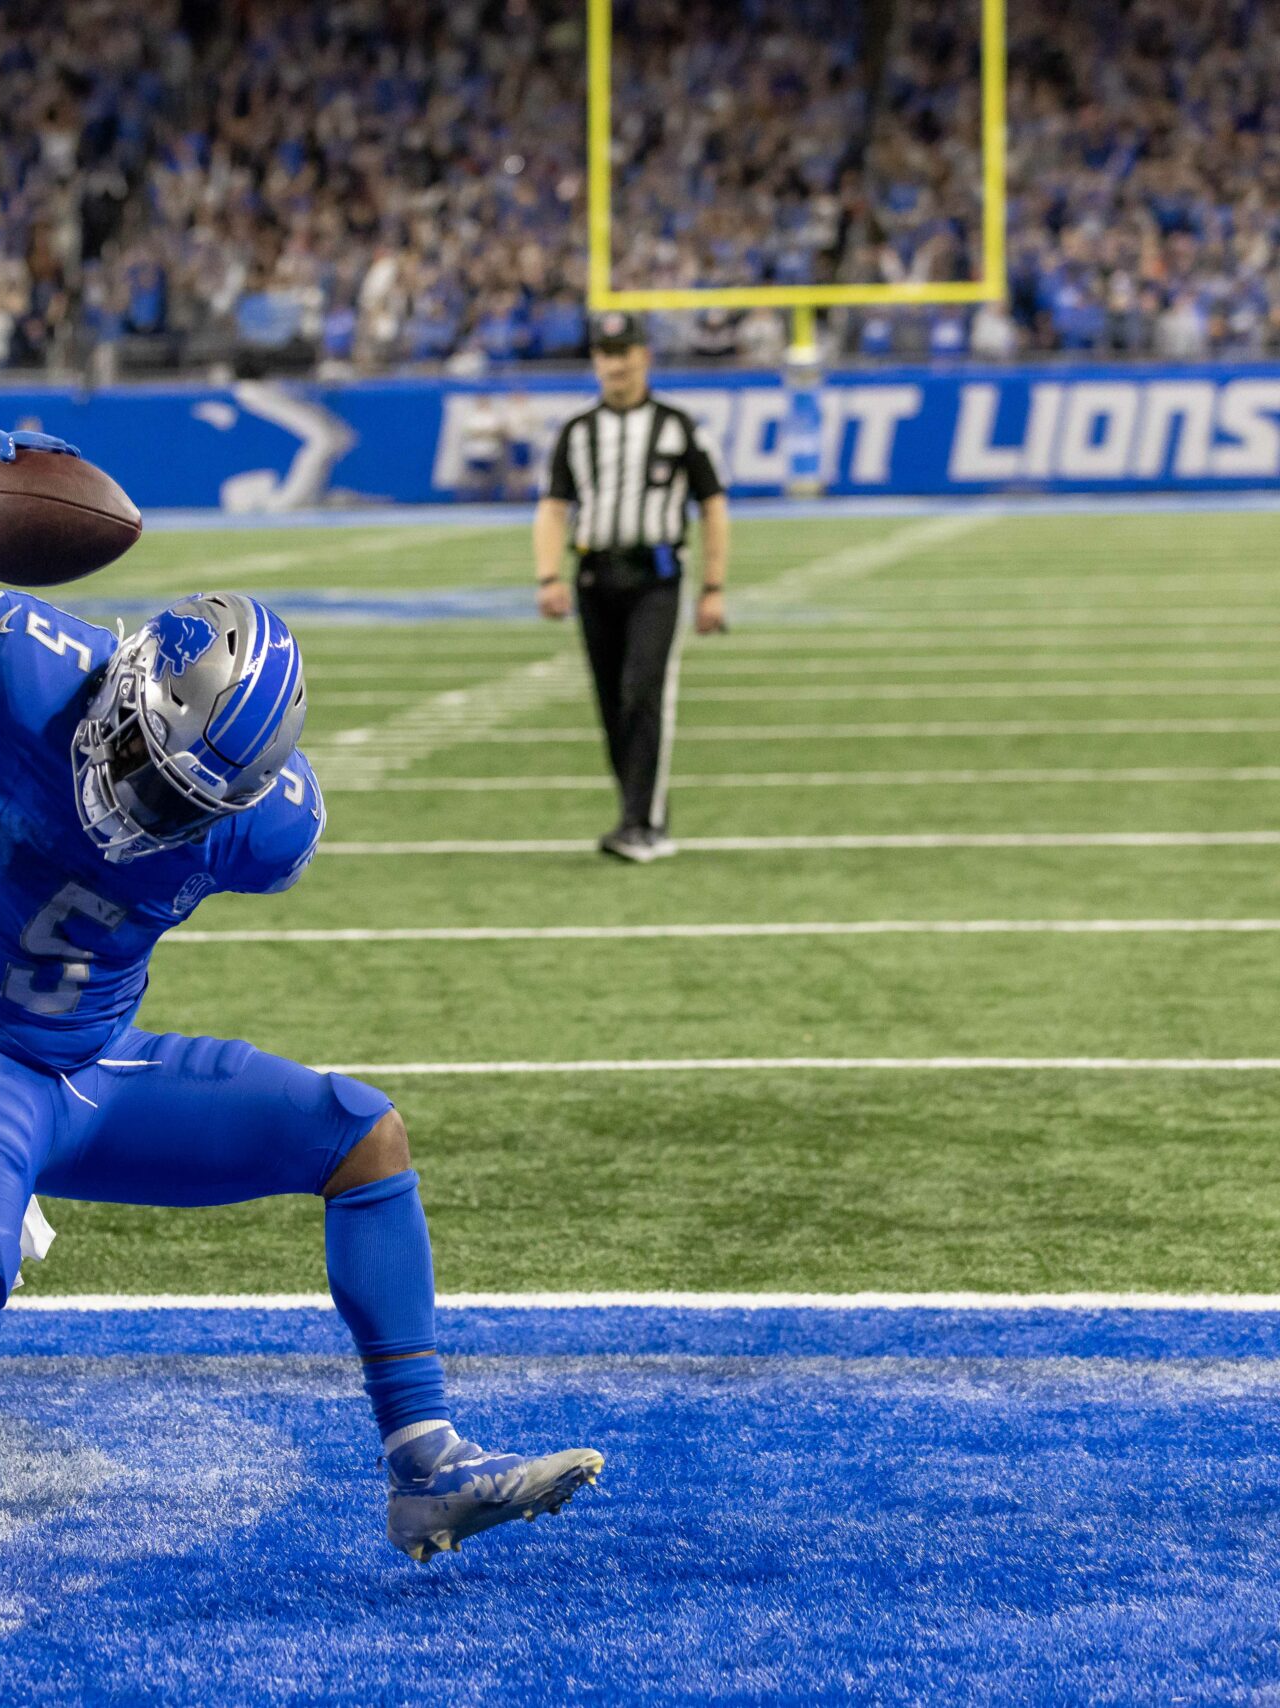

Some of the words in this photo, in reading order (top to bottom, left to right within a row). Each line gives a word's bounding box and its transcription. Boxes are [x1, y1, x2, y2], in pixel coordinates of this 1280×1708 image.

[947, 378, 1280, 482] LIONS
[26, 611, 93, 674] 5
[0, 881, 126, 1016] 5
